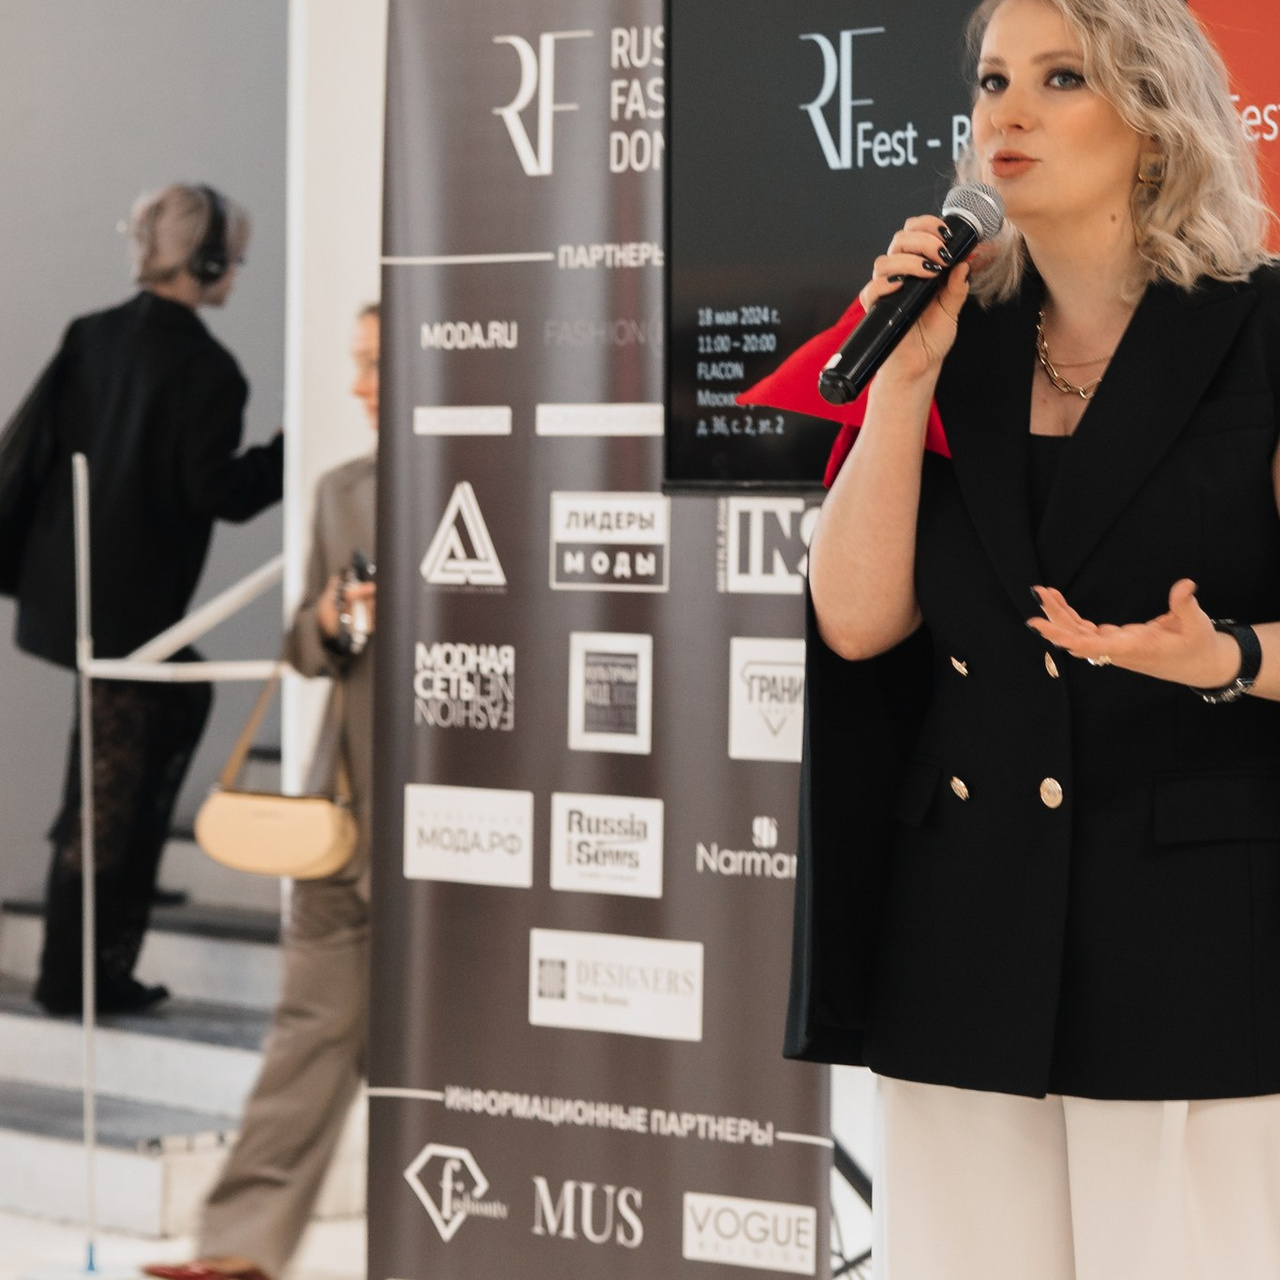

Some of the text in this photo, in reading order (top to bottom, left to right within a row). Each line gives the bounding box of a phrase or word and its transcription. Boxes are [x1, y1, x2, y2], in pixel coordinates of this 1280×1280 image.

[856, 121, 919, 168] Fest
[420, 320, 518, 350] MODA.RU
[566, 510, 656, 531] ЛИДЕРЫ
[563, 549, 657, 579] МОДЫ
[414, 641, 515, 676] МОДНАЯ
[414, 669, 476, 701] СЕТЬ
[567, 808, 648, 840] Russia
[575, 959, 696, 996] DESIGNERS
[445, 1084, 775, 1148] ИНФОРМАЦИОННЫЕ ПАРТНЕРЫ
[531, 1175, 645, 1249] MUS
[689, 1204, 810, 1250] VOGUE
